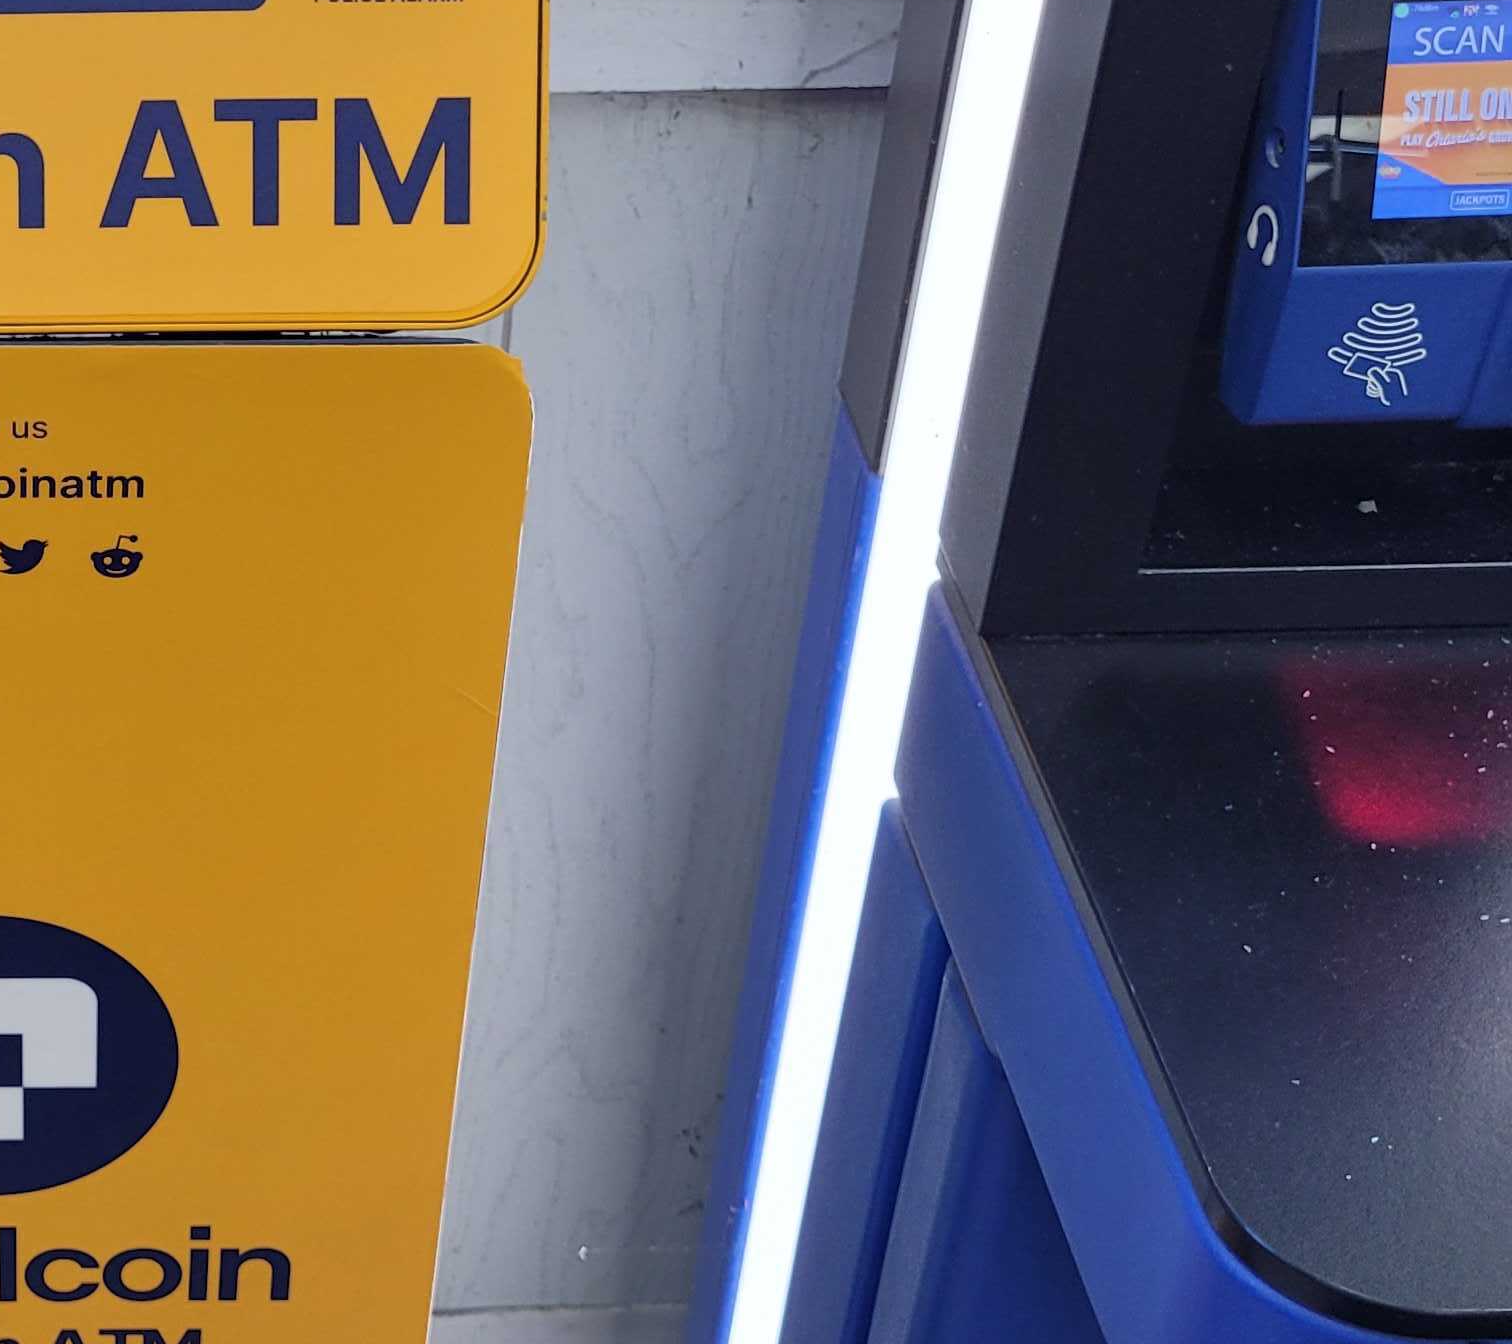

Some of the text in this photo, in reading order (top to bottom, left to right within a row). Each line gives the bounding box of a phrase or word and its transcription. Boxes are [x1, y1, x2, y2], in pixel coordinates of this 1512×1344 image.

[1412, 23, 1505, 57] SCAN
[1403, 87, 1474, 124] STILL
[97, 96, 473, 229] ATM
[1453, 192, 1506, 206] JACKPOTS
[10, 417, 49, 441] us
